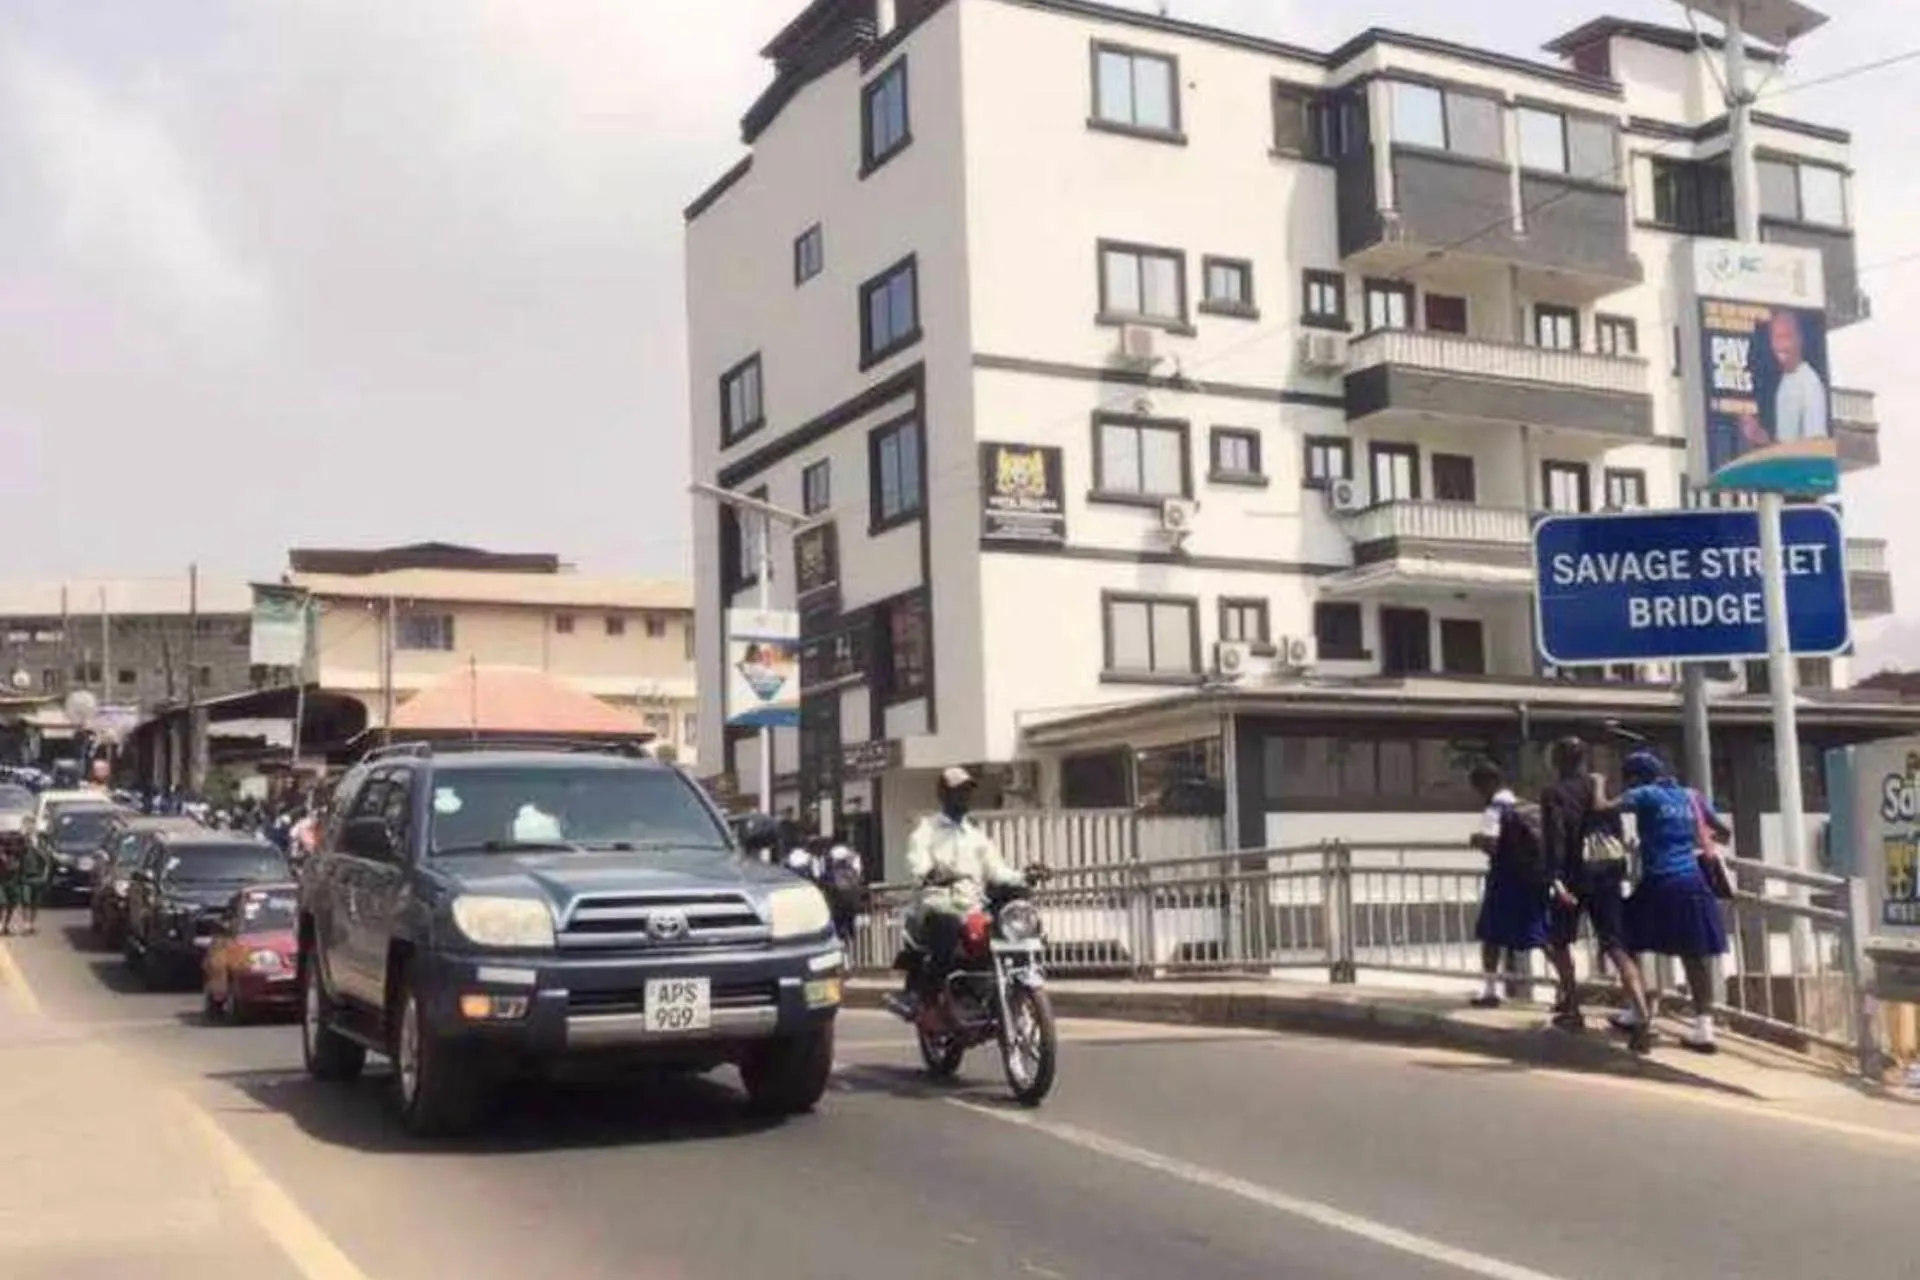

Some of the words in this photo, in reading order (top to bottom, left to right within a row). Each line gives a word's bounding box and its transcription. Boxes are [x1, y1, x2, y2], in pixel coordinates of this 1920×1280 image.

[1552, 549, 1692, 585] SAVAGE
[1701, 543, 1827, 579] STRET
[1629, 592, 1765, 629] BRIDGE
[659, 983, 698, 1004] APS
[655, 1006, 694, 1029] 909
